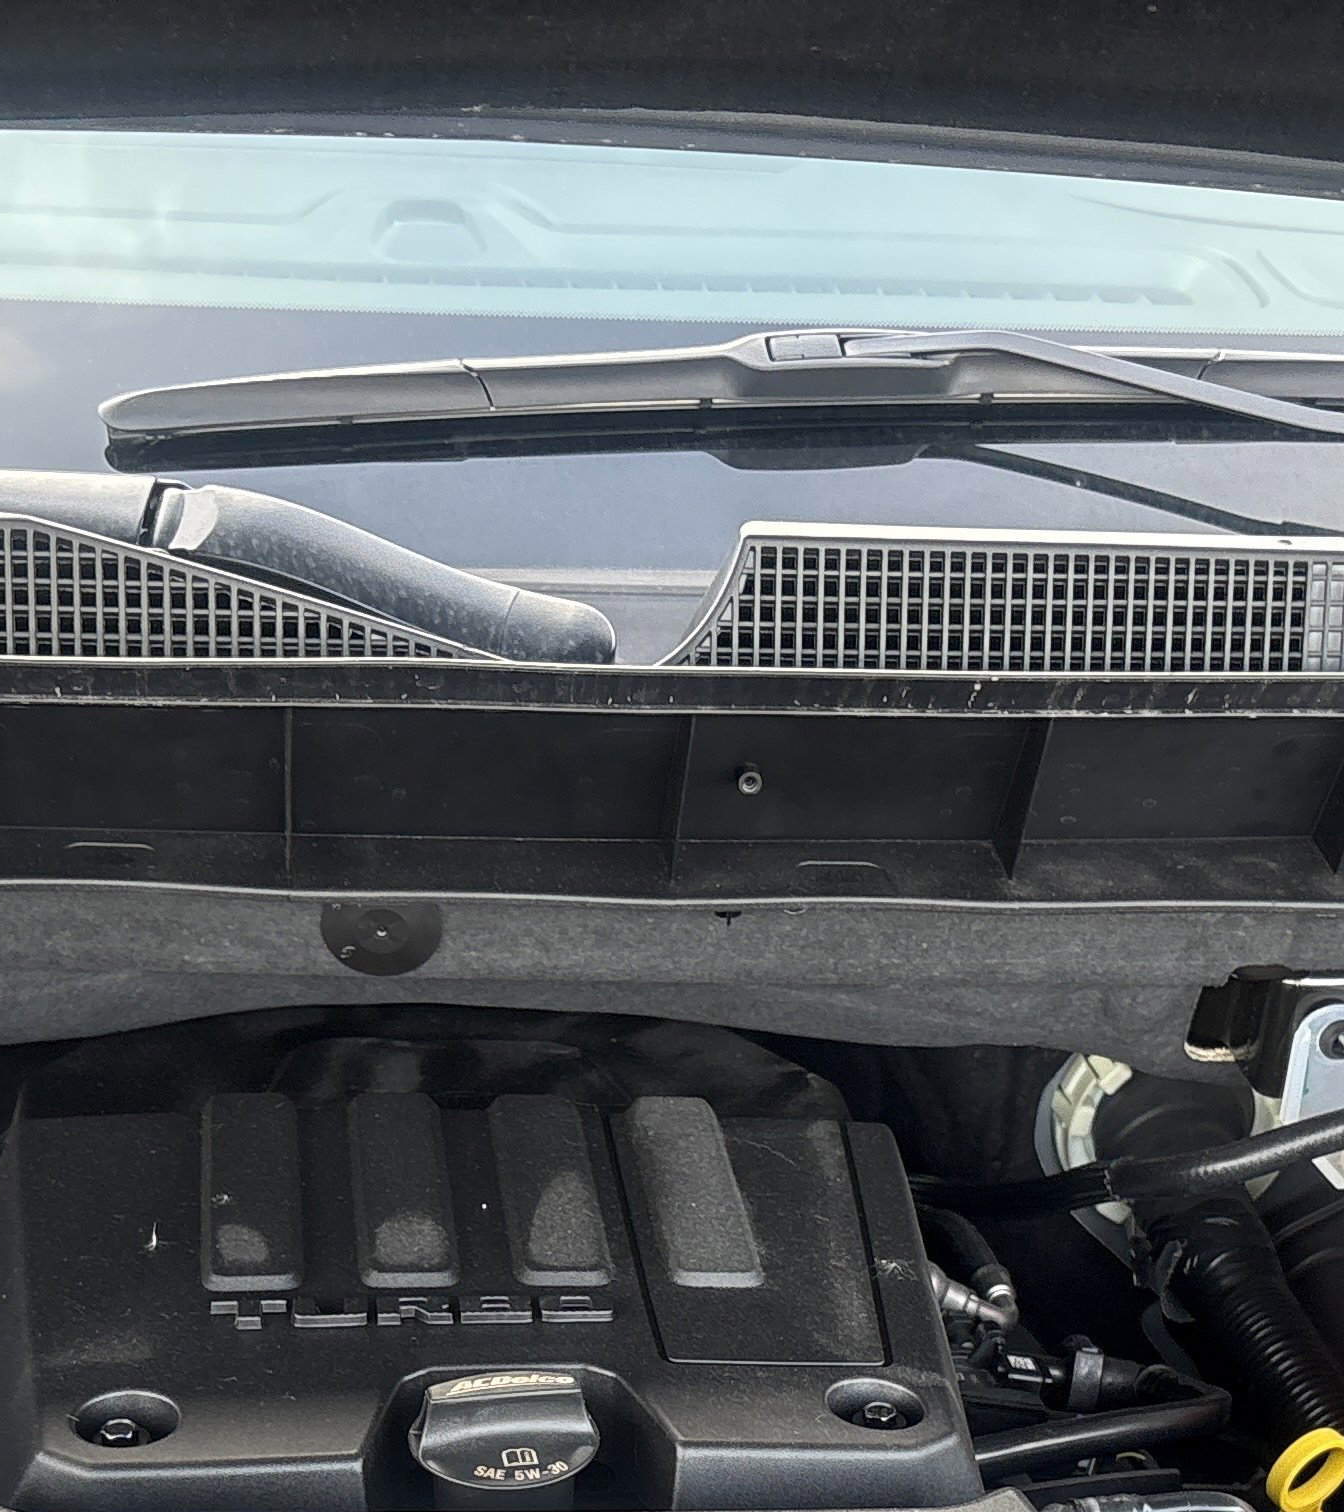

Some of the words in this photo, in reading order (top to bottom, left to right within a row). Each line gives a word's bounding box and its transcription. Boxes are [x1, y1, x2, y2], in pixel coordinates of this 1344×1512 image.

[209, 1295, 614, 1330] TURBO
[451, 1373, 575, 1397] ACDelco
[473, 1464, 505, 1481] SAE
[514, 1460, 569, 1481] 5W-30
